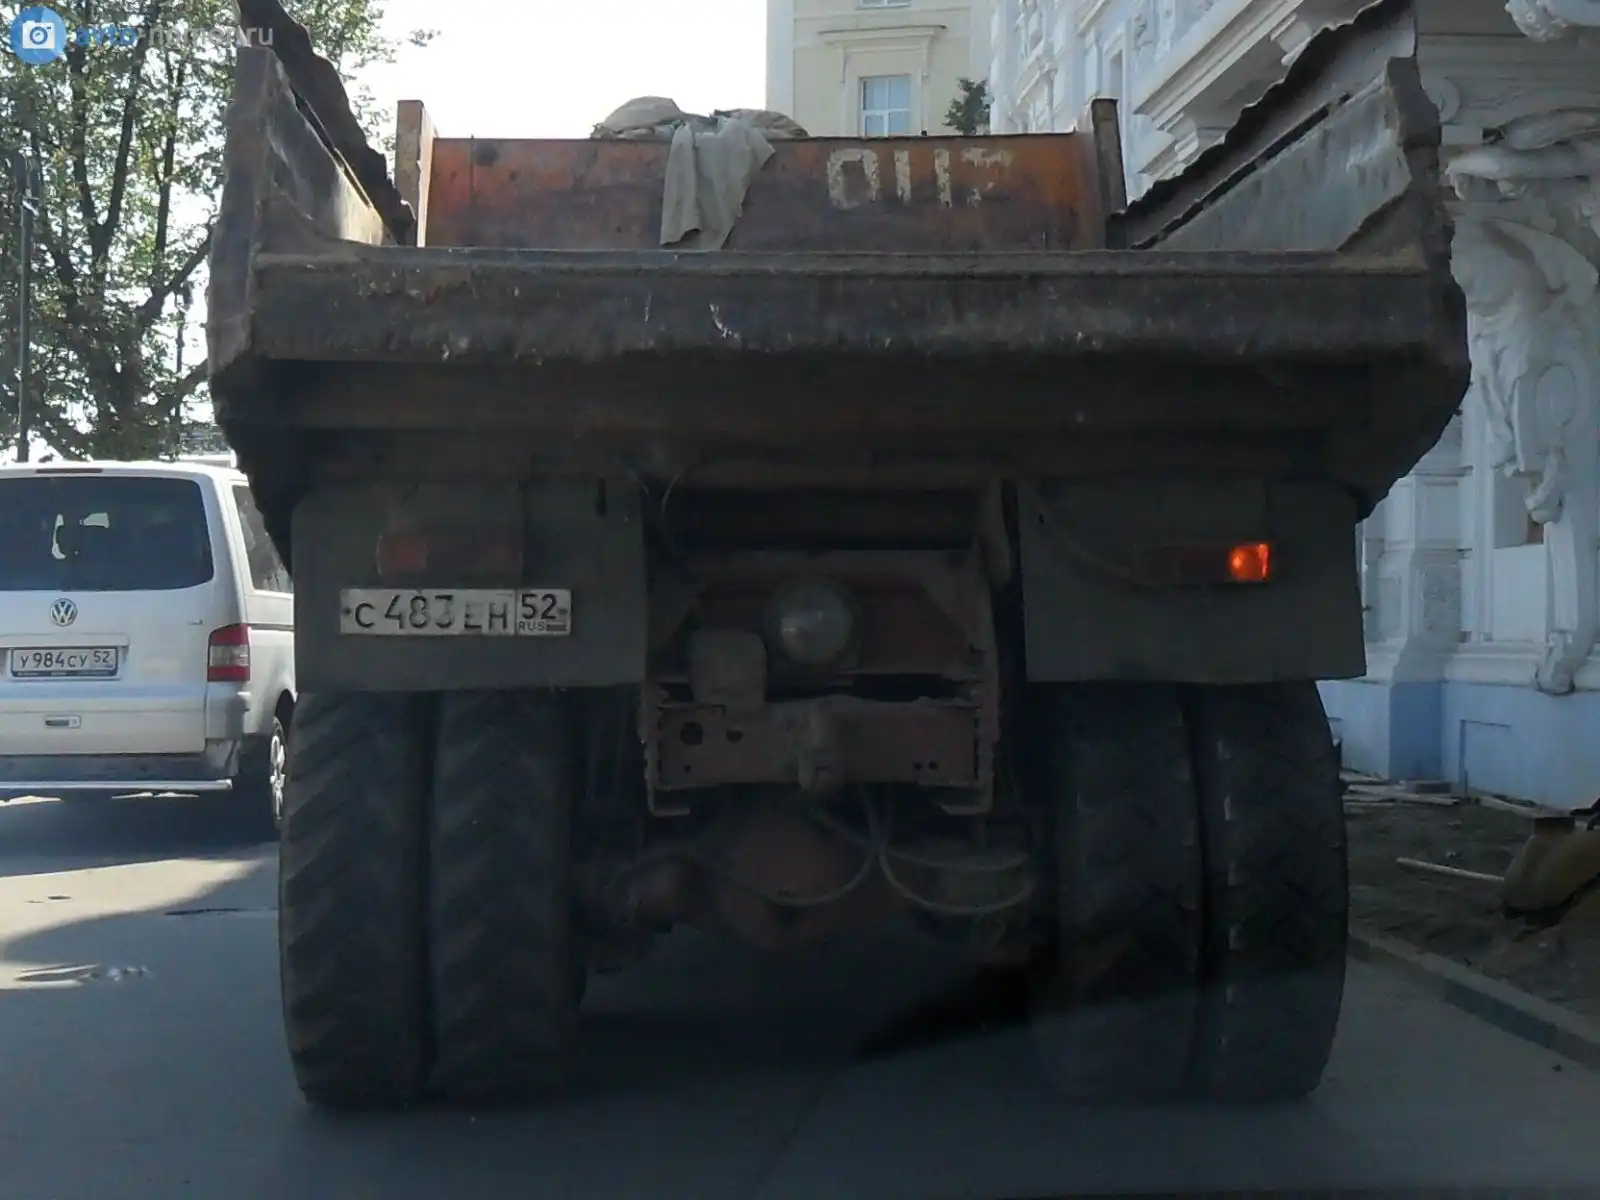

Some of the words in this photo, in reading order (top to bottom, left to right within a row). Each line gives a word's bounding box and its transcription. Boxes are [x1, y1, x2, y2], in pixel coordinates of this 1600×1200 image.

[520, 593, 558, 620] 52
[517, 621, 546, 632] RUS
[92, 650, 110, 663] 52
